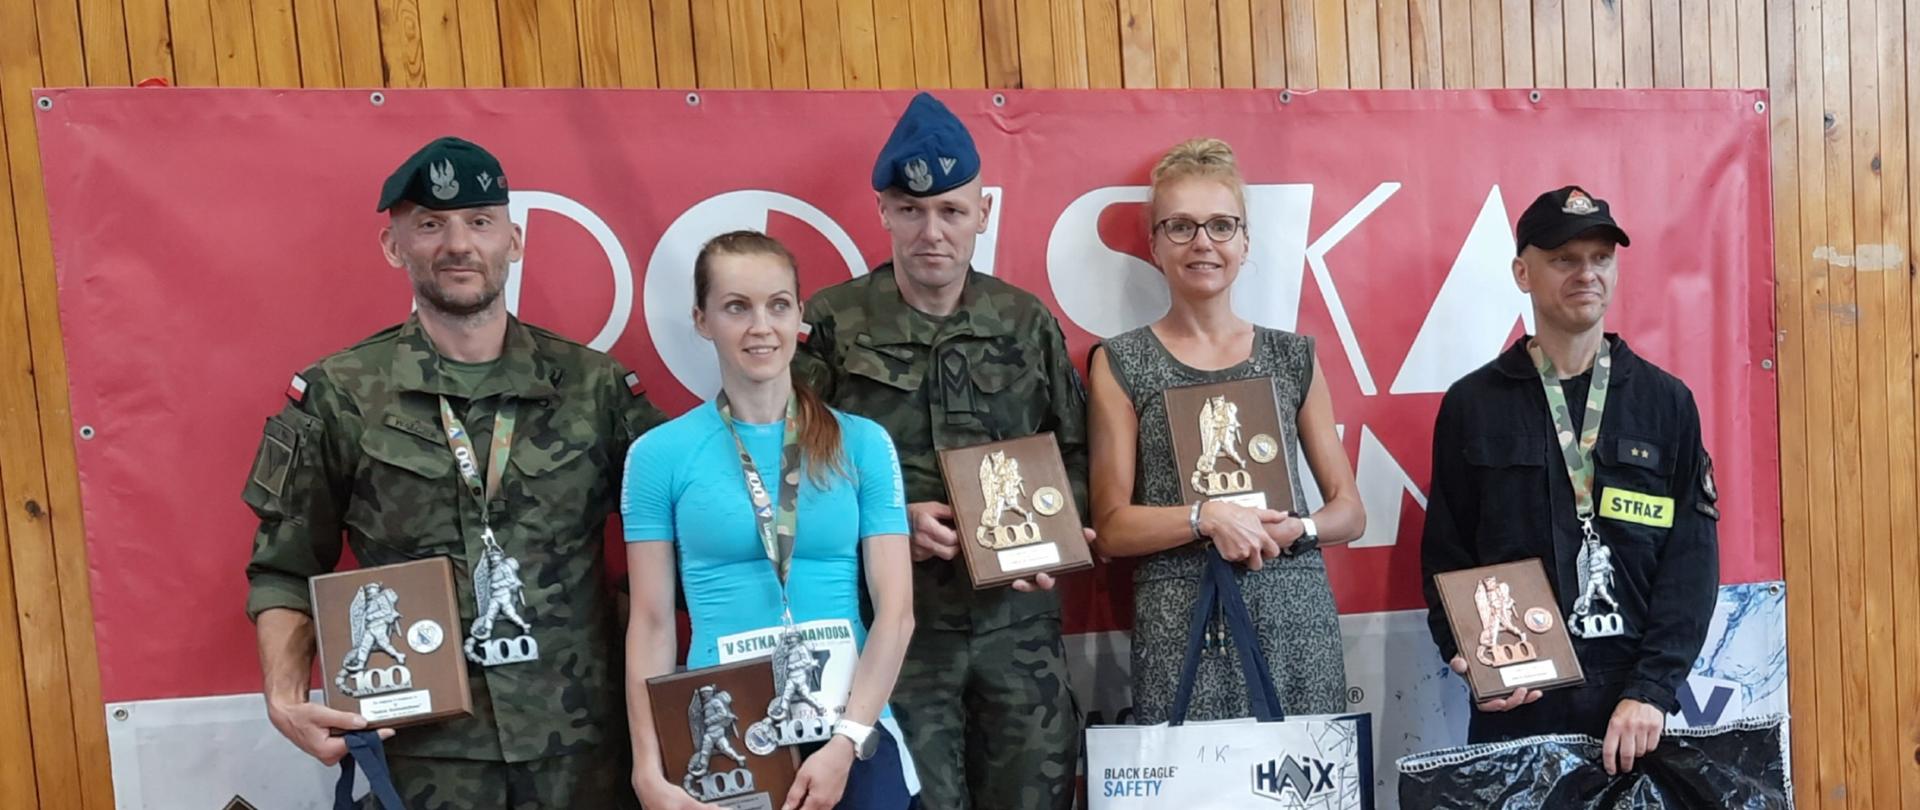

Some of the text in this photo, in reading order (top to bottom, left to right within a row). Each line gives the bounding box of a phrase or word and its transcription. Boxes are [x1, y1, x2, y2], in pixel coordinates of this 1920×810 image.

[1203, 470, 1254, 496] 100
[988, 522, 1042, 550] 100
[1580, 612, 1625, 639] 100
[479, 635, 539, 666] 100
[736, 634, 777, 653] SETKA
[351, 665, 413, 698] 100
[695, 768, 755, 802] 100
[1104, 767, 1140, 780] BLACK
[1104, 779, 1162, 797] SAFETY
